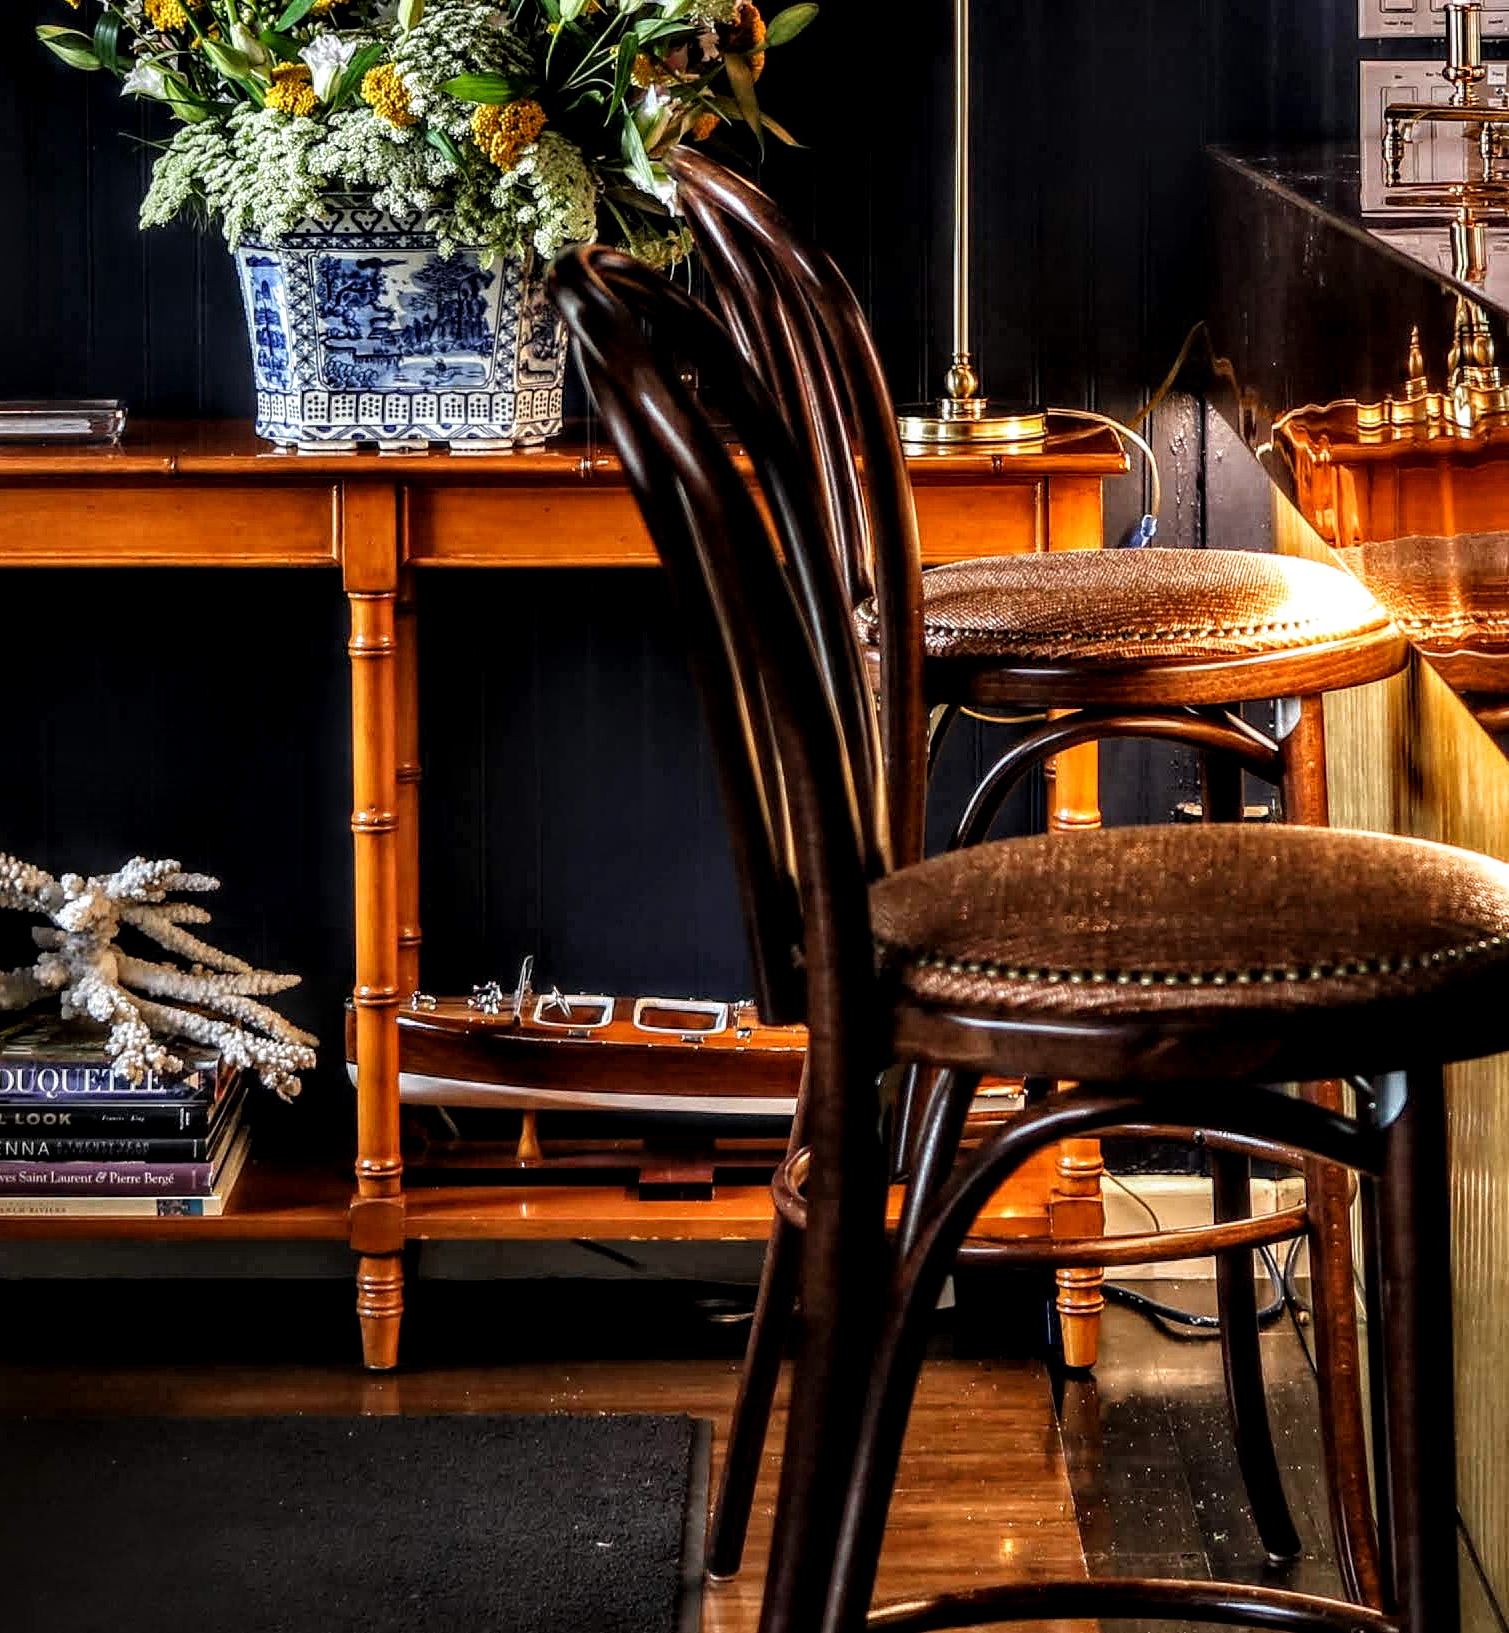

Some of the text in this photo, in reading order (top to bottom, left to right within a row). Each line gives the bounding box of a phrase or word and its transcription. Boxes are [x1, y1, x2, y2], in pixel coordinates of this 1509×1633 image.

[15, 1112, 72, 1125] LOOK
[19, 1170, 47, 1184] Saint
[51, 1171, 92, 1184] Laurent
[95, 1171, 107, 1184] &
[109, 1171, 141, 1184] Pierre
[144, 1171, 175, 1186] Bergé
